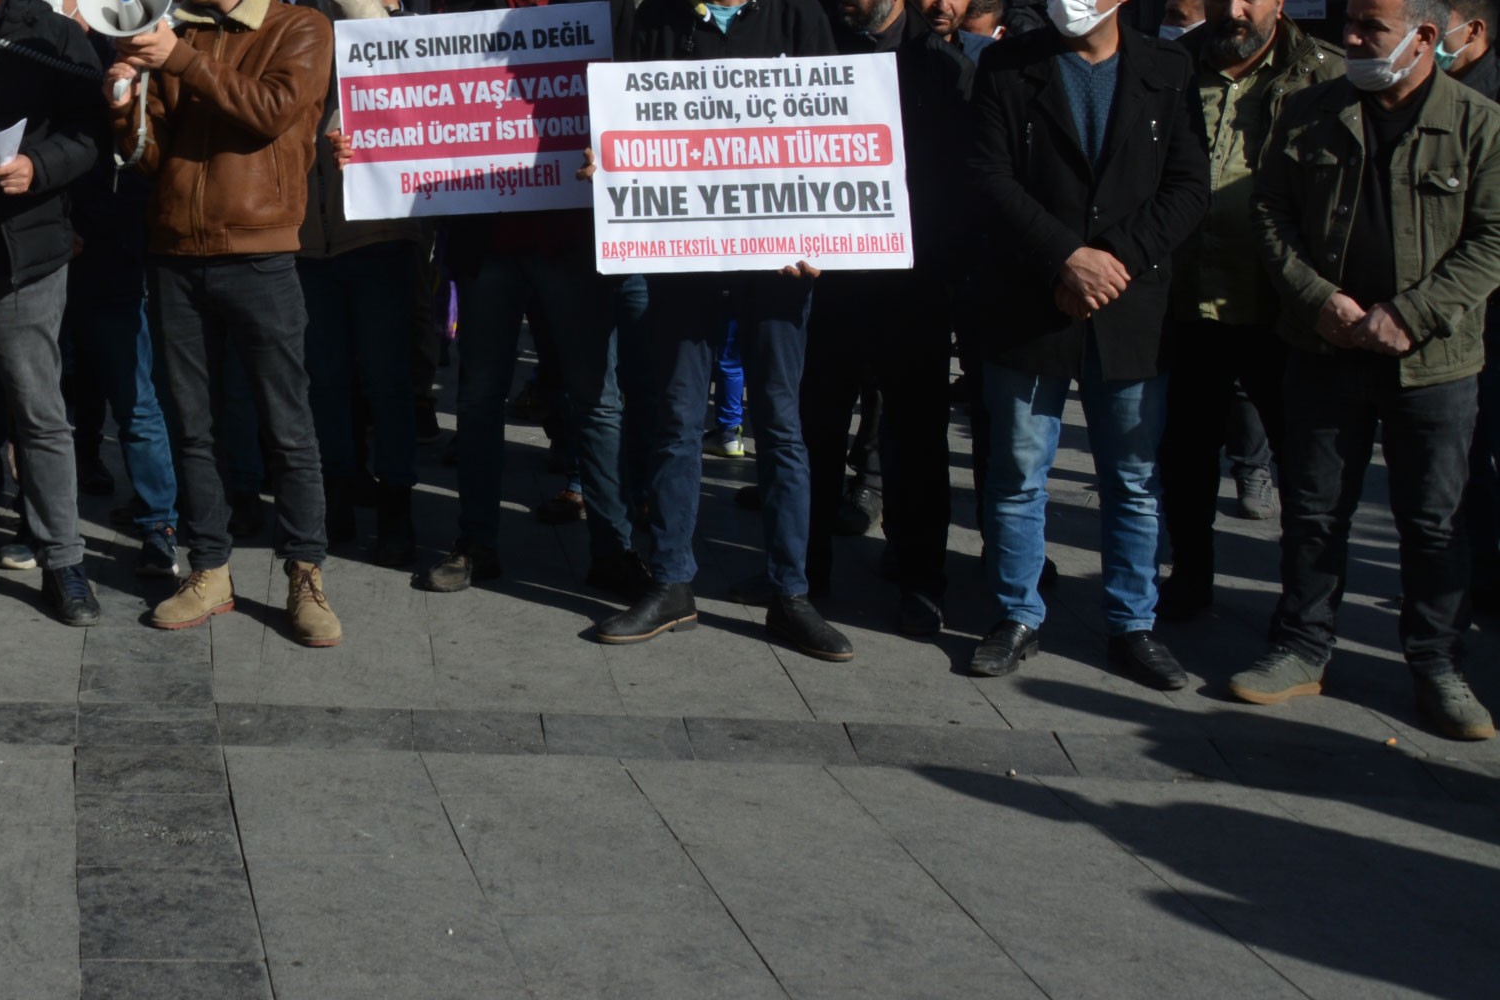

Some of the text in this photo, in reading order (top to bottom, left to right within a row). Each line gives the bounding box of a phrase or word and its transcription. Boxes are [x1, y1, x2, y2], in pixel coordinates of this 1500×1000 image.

[348, 21, 595, 68] AÇLIK SINIRINDA DEĞİL
[350, 73, 588, 112] İNSANCA YAŞAYACA
[625, 62, 855, 92] ASGARİ ÜCRETLİ AİLE
[635, 93, 849, 124] HER GÜN, ÜÇ ÖĞÜN
[351, 114, 590, 150] ASGARİ ÜCRET İSTİYORU
[613, 130, 881, 168] NOHUT+AYRAN TÜKETSE
[401, 160, 562, 200] BAŞPINAR İŞÇİLERİ
[607, 174, 893, 218] YİNE YETMİYOR!
[602, 232, 905, 262] BAŞPINAR TEKSTİL VE DOKUMA İŞÇİLERİ BİRLİĞİ
